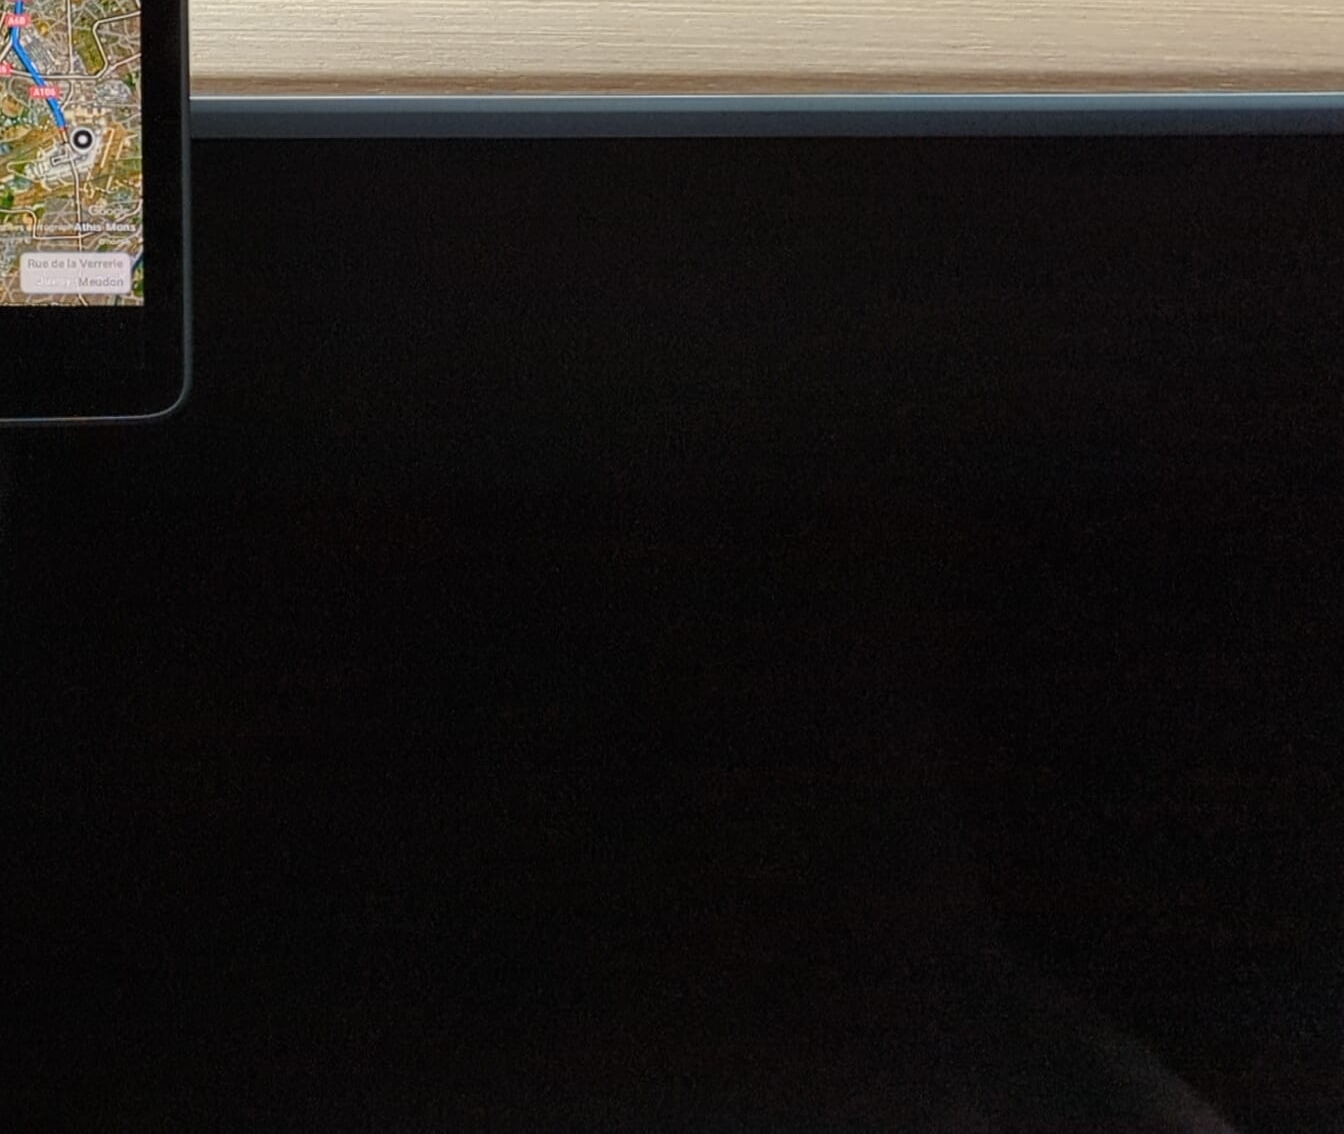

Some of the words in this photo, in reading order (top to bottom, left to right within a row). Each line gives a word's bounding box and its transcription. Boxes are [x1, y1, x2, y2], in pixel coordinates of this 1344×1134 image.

[28, 258, 49, 268] Rue
[51, 258, 65, 268] de
[67, 258, 77, 268] la
[79, 258, 124, 268] Verrerie
[78, 276, 124, 287] Meudon
